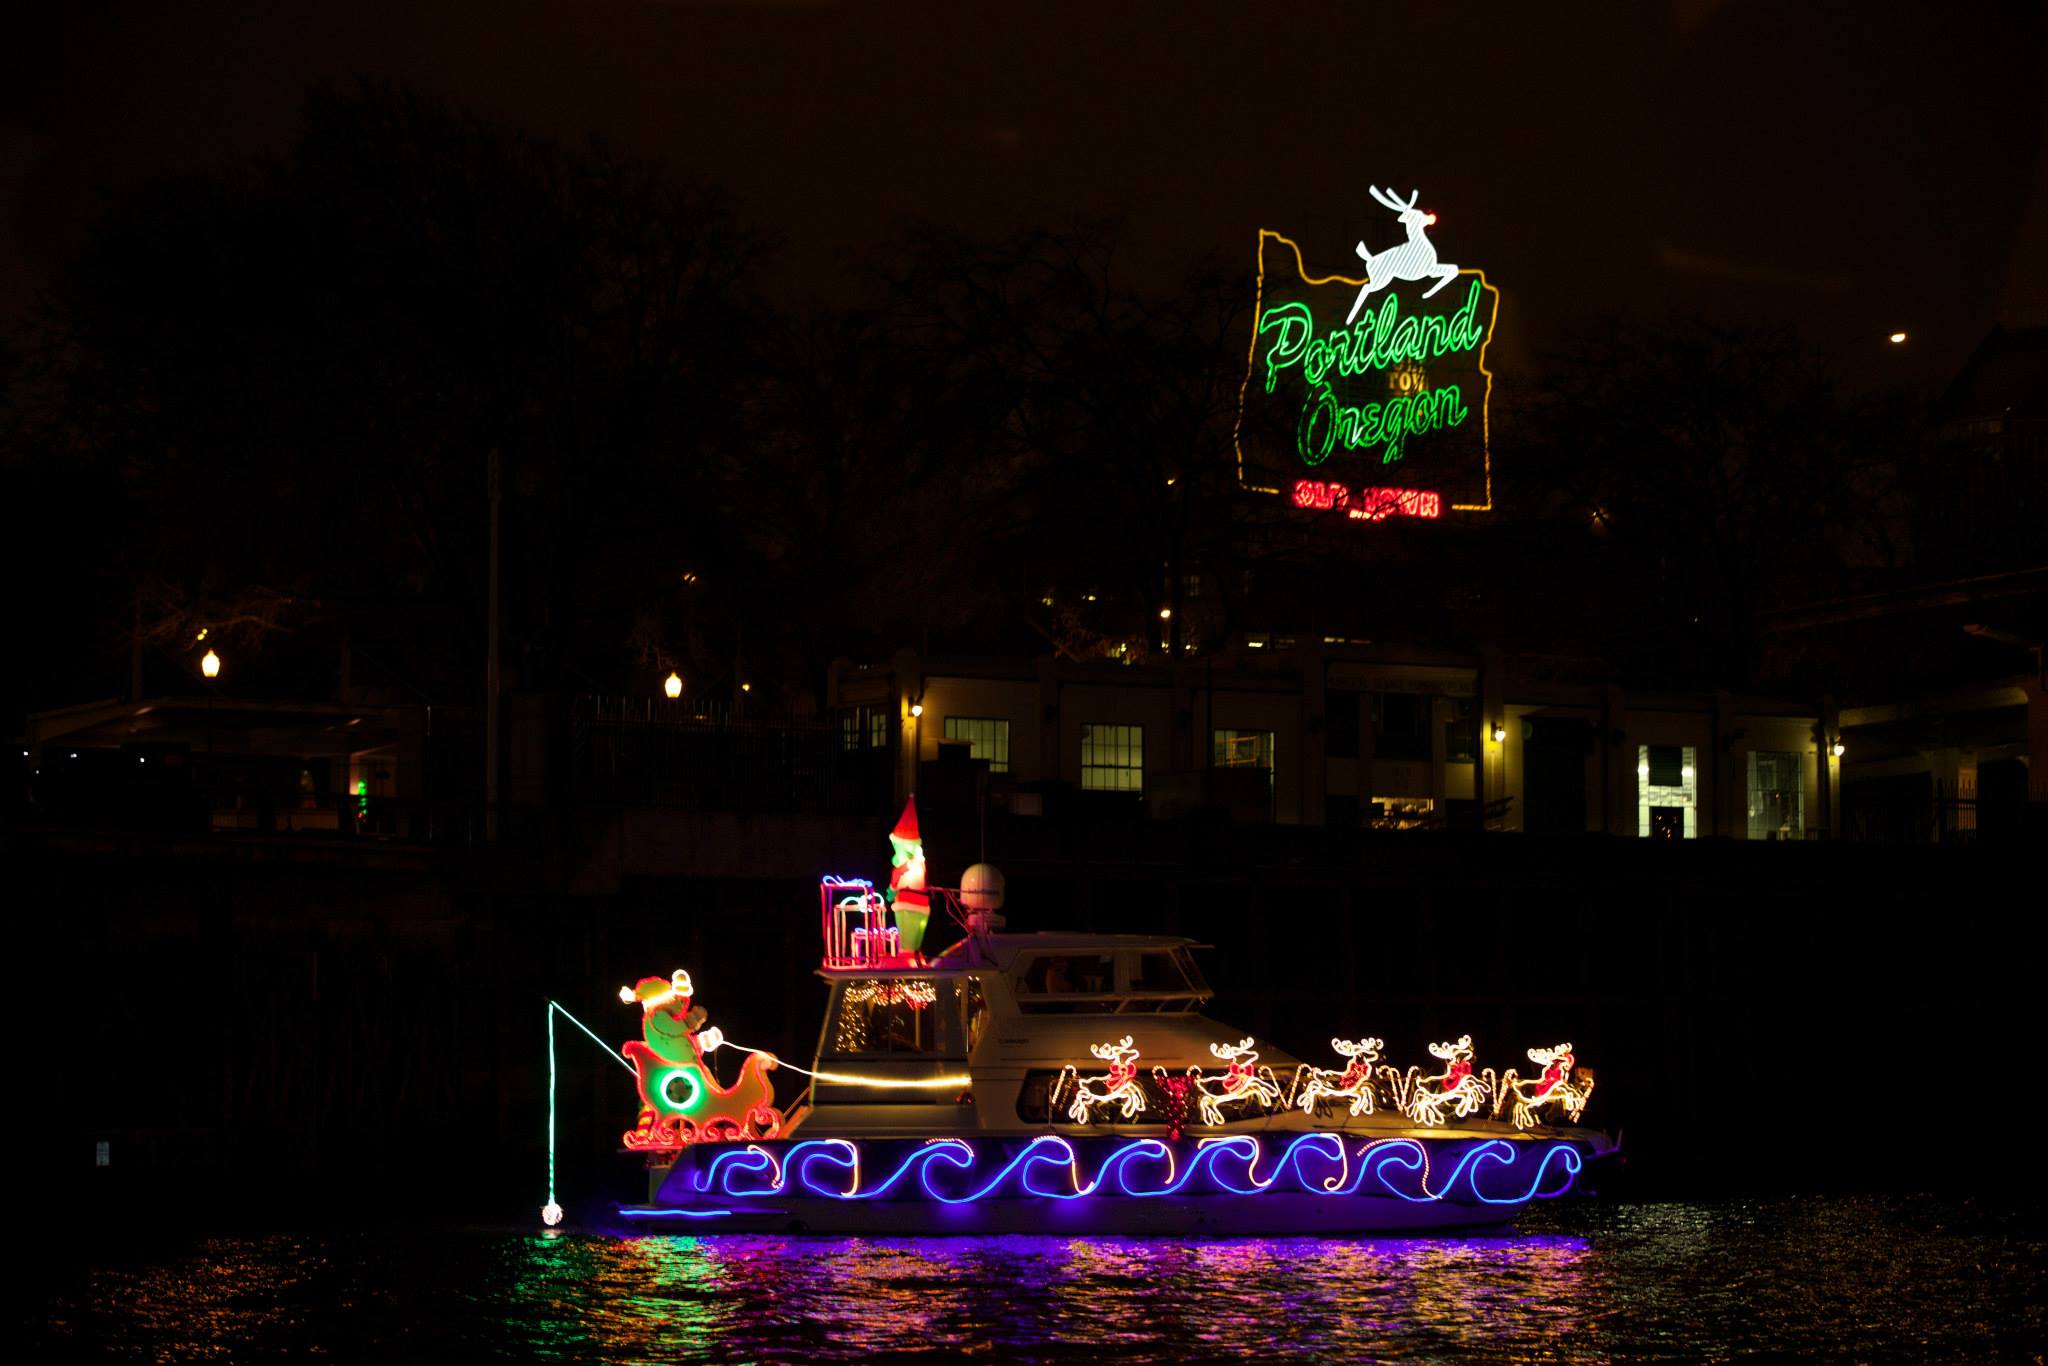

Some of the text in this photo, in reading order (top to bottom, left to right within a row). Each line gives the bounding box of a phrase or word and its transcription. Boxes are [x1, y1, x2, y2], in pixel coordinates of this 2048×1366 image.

[1259, 279, 1483, 393] Portland
[1297, 380, 1468, 467] Oregon
[1294, 479, 1349, 510] OLD
